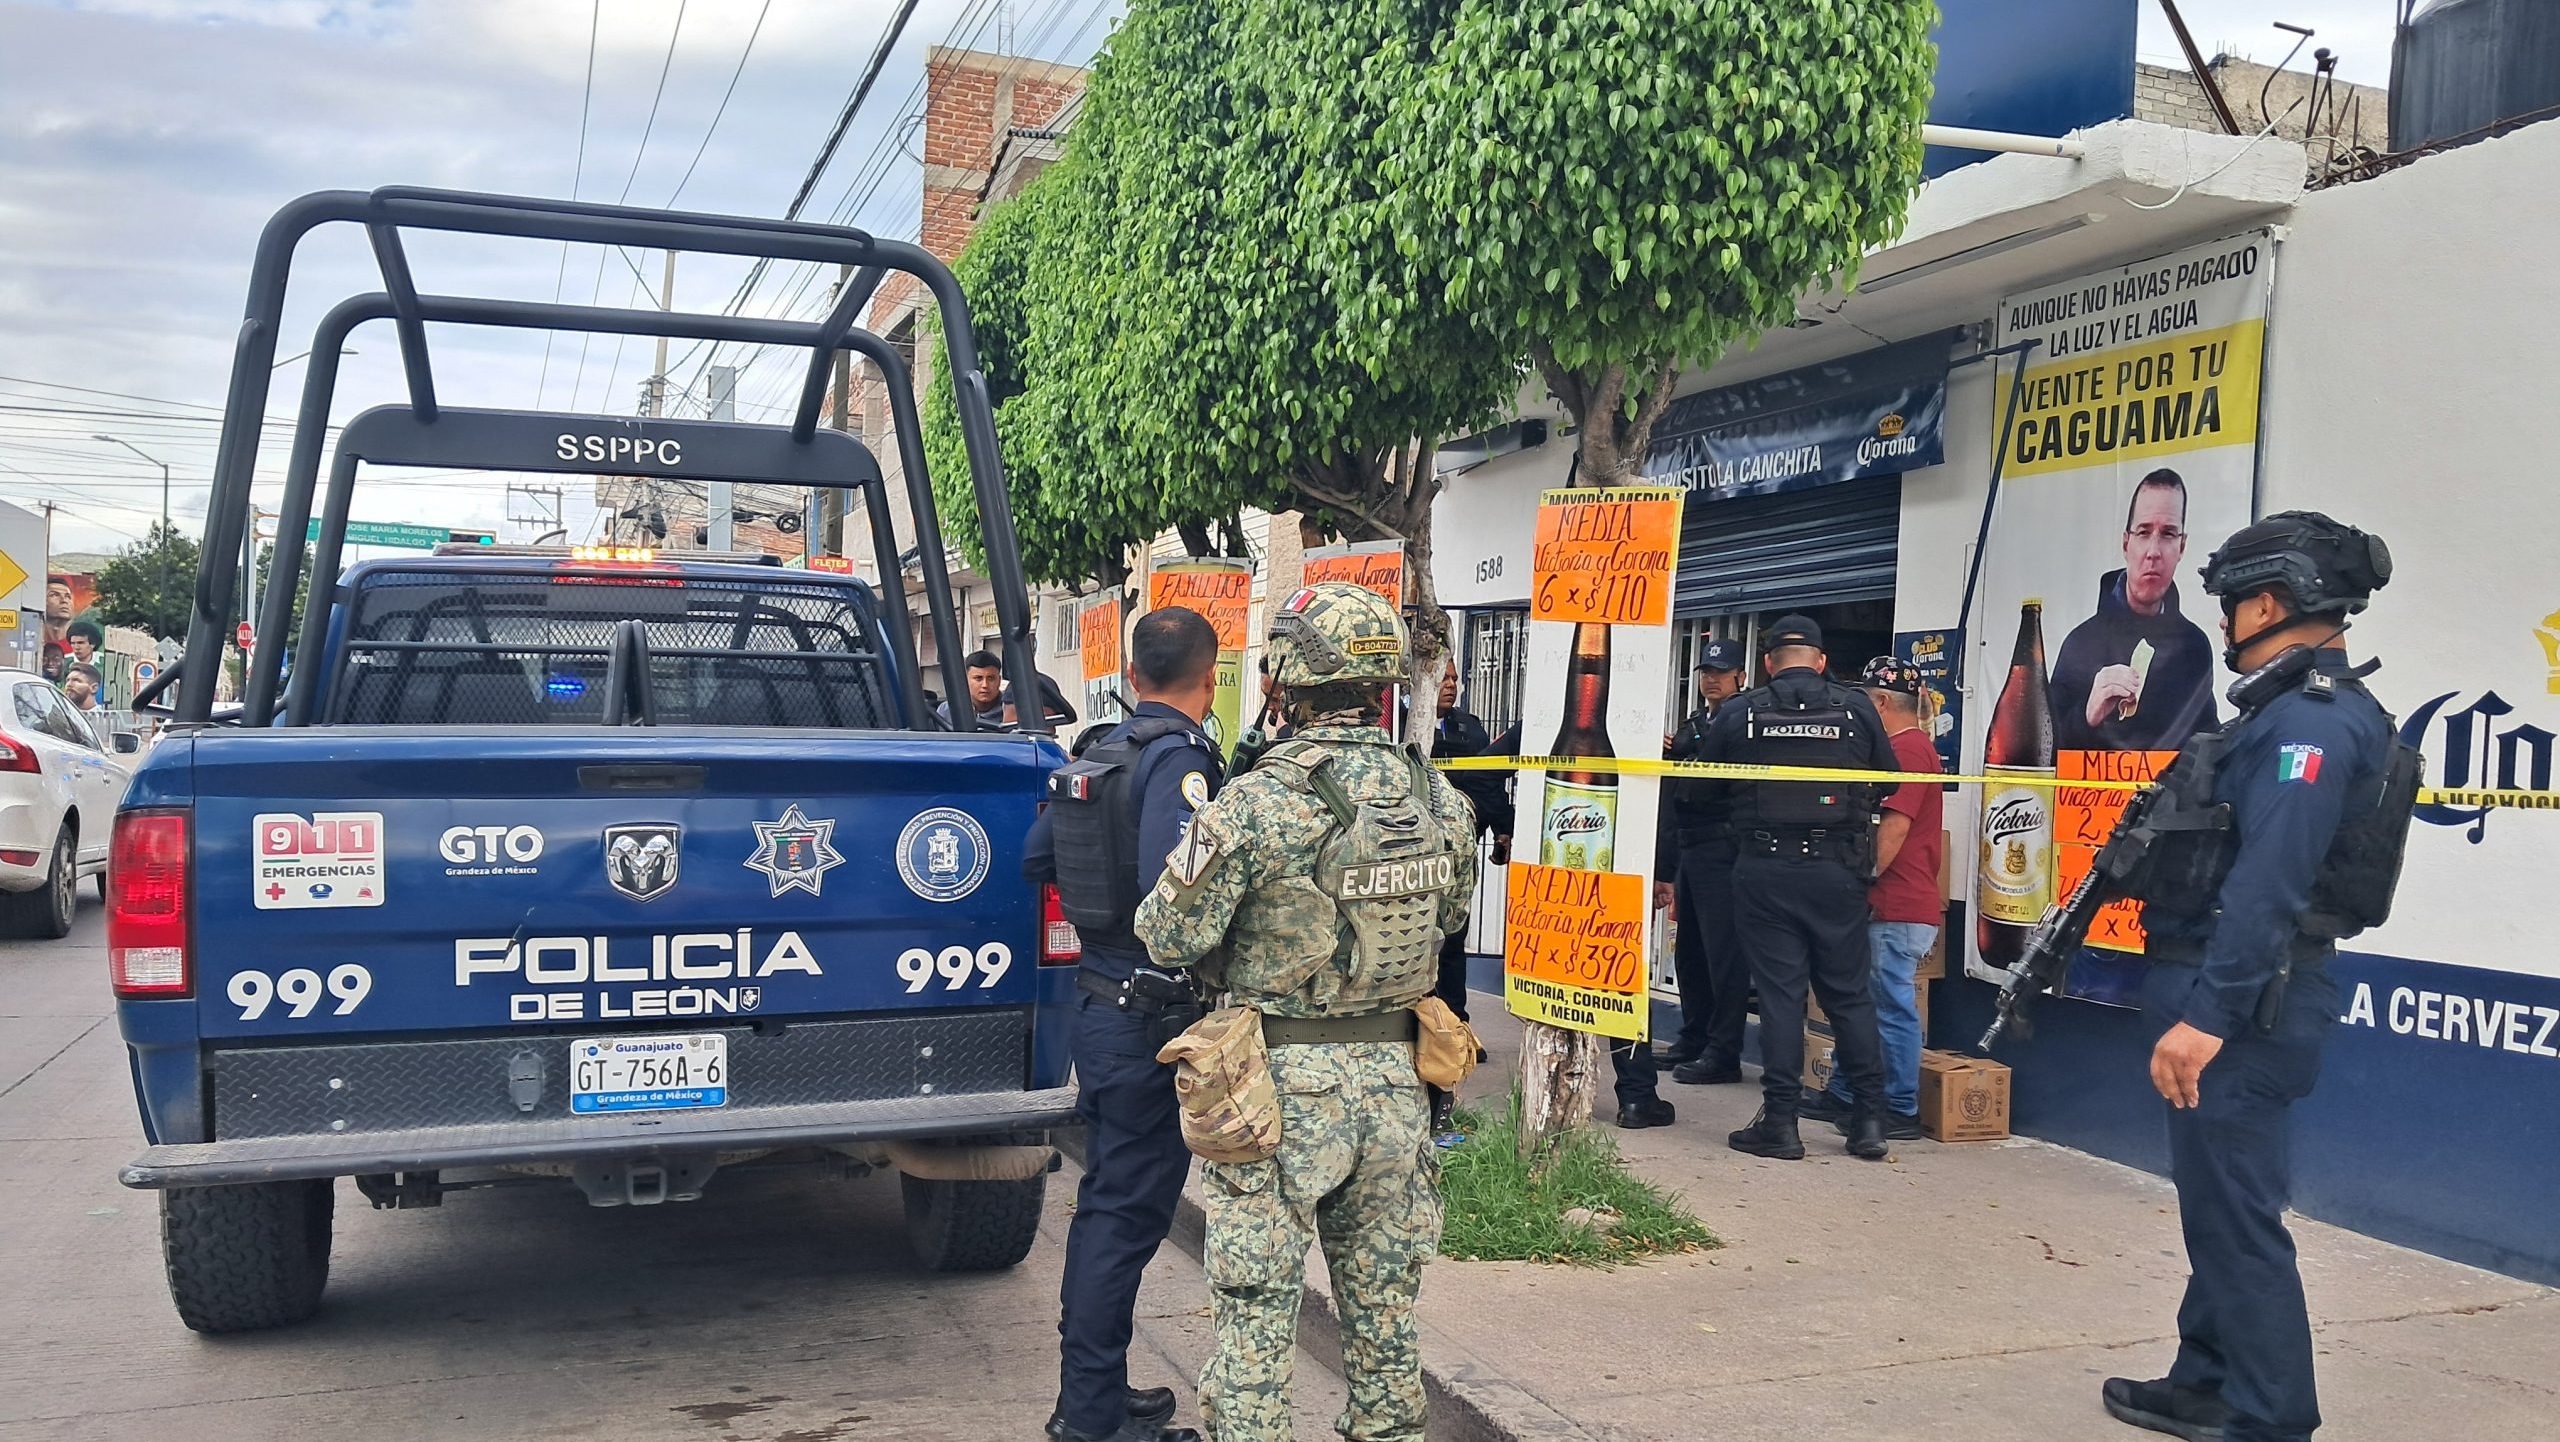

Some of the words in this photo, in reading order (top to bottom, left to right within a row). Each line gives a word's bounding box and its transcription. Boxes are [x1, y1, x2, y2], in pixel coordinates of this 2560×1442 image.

[2010, 292, 2077, 332] AUNQUE
[2082, 284, 2106, 314] NO
[2112, 268, 2169, 307] HAYAS
[2175, 246, 2258, 292] PAGADO
[2050, 330, 2069, 357] LA
[2074, 321, 2104, 352] LUZ
[2110, 316, 2120, 344] Y
[2124, 313, 2142, 340] EL
[2147, 299, 2198, 336] AGUA
[2020, 366, 2104, 413] VENTE
[2117, 352, 2174, 395] POR
[2189, 340, 2228, 381] TU
[2016, 385, 2221, 464] CAGUAMA
[556, 434, 682, 466] SSPPC
[1739, 445, 1822, 484] CANCHITA
[1857, 435, 1916, 467] Corona
[1553, 504, 1637, 542] MEDIA
[814, 559, 848, 568] FLETES
[1475, 555, 1504, 584] 1588
[1533, 543, 1592, 573] Victoria
[1609, 540, 1670, 577] Corona
[1159, 573, 1246, 600] FAMILIAR
[1538, 574, 1558, 613] 6
[239, 629, 252, 640] ALTO
[2082, 751, 2153, 781] MEGA
[2059, 786, 2126, 808] Victoria
[270, 825, 364, 851] 911
[1549, 804, 1607, 842] Victoria
[1985, 797, 2045, 845] Victoria
[2077, 808, 2101, 840] 2
[439, 825, 545, 863] GTO
[262, 865, 376, 878] EMERGENCIAS
[445, 867, 489, 876] Grandeza
[491, 867, 503, 876] de
[505, 866, 538, 876] México
[1343, 855, 1450, 896] EJERCITO
[1519, 866, 1607, 909] MEDIA
[1507, 897, 1574, 934] Victoria
[1587, 909, 1642, 949] Corona
[456, 927, 823, 986] POLICÍA
[896, 942, 1012, 994] 999
[1511, 931, 1541, 972] 24
[227, 963, 372, 1021] 999
[510, 993, 583, 1020] DE
[600, 985, 737, 1018] LEÓN
[1513, 977, 1569, 1005] VICTORIA,
[1573, 991, 1634, 1014] CORONA
[1541, 1002, 1548, 1015] Y
[1551, 1006, 1595, 1025] MEDIA
[2339, 982, 2376, 1028] A
[2388, 986, 2560, 1058] CERVEZ
[615, 1041, 684, 1053] Guanajuato
[577, 1055, 721, 1091] GT-756A-6
[596, 1091, 648, 1103] Grandeza
[650, 1090, 663, 1100] de
[665, 1089, 703, 1100] México
